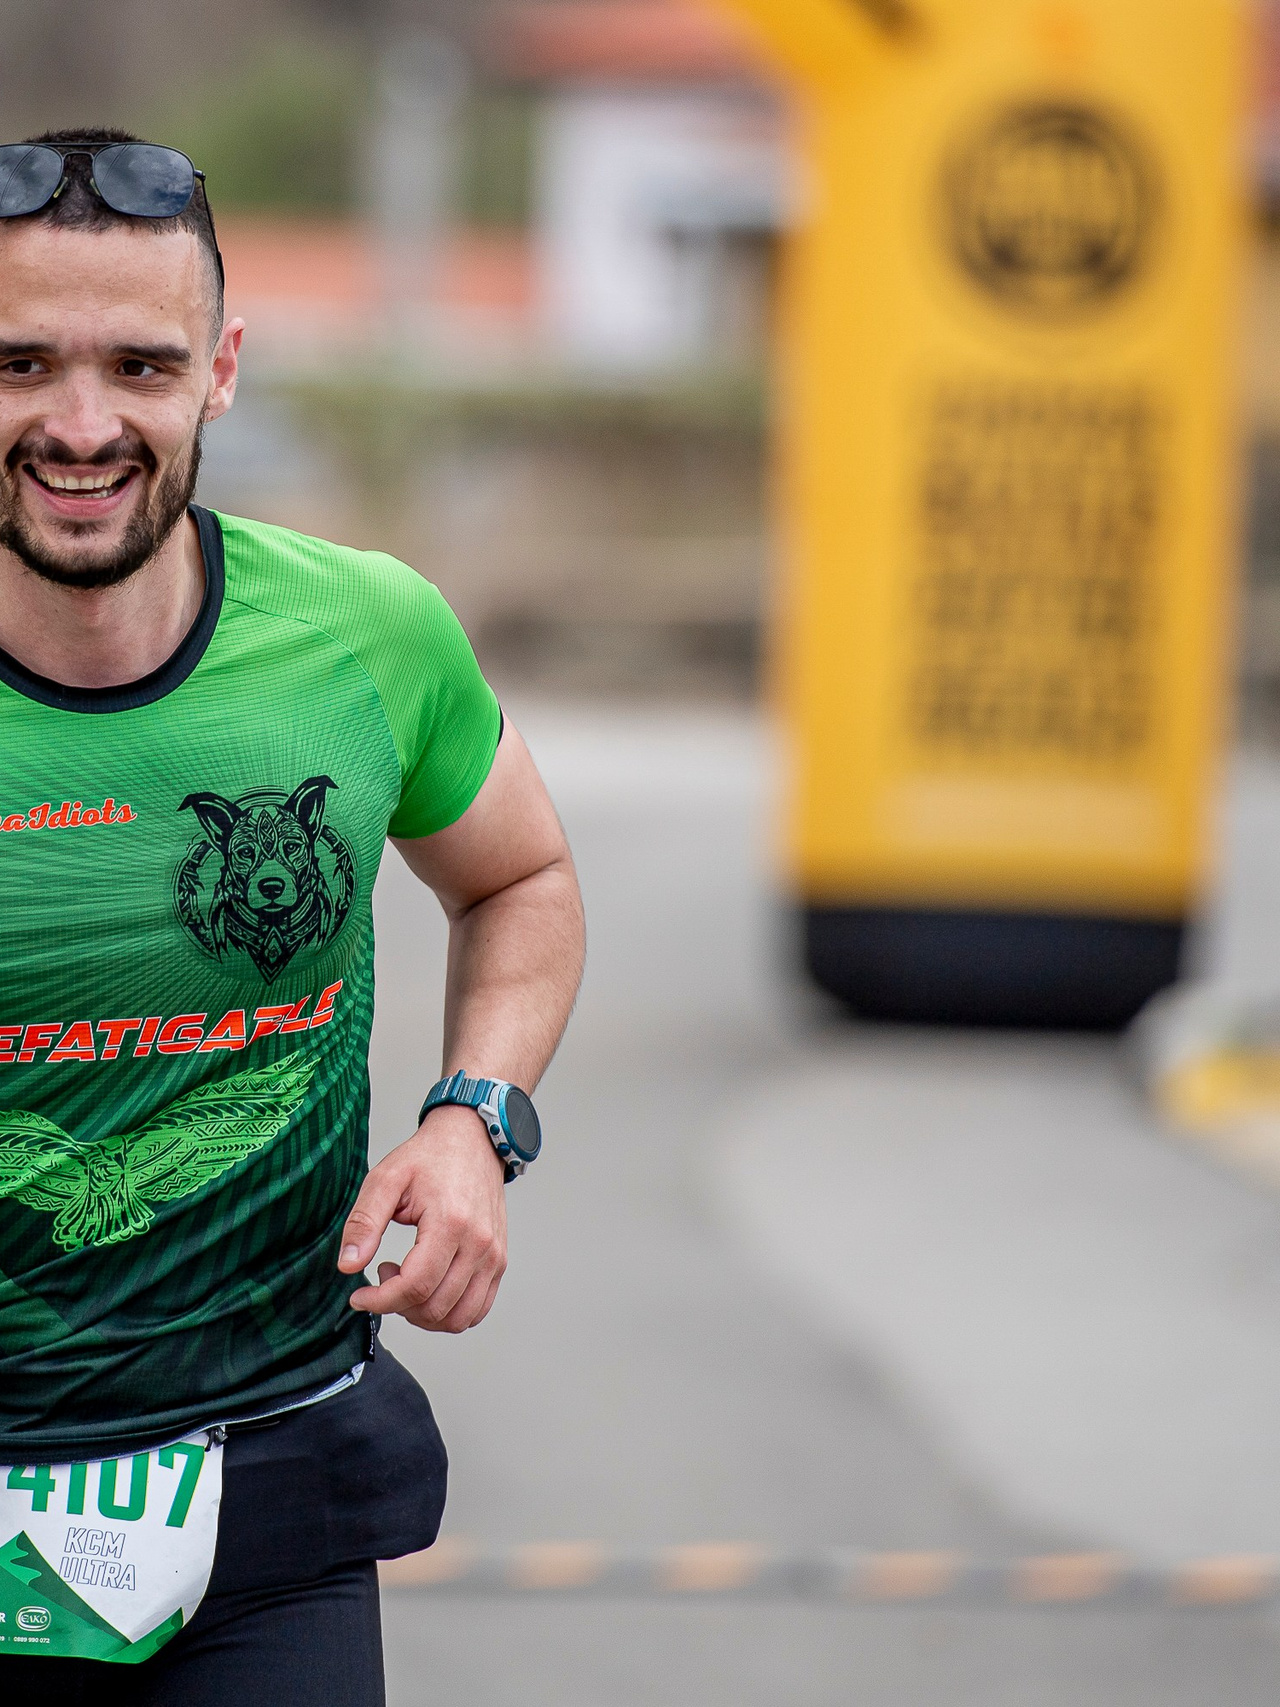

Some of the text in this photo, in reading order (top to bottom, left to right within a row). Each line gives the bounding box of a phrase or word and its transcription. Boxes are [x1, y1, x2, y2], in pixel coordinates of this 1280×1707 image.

[6, 1441, 205, 1529] 4107
[64, 1527, 126, 1559] KCM
[58, 1557, 136, 1591] ULTRA
